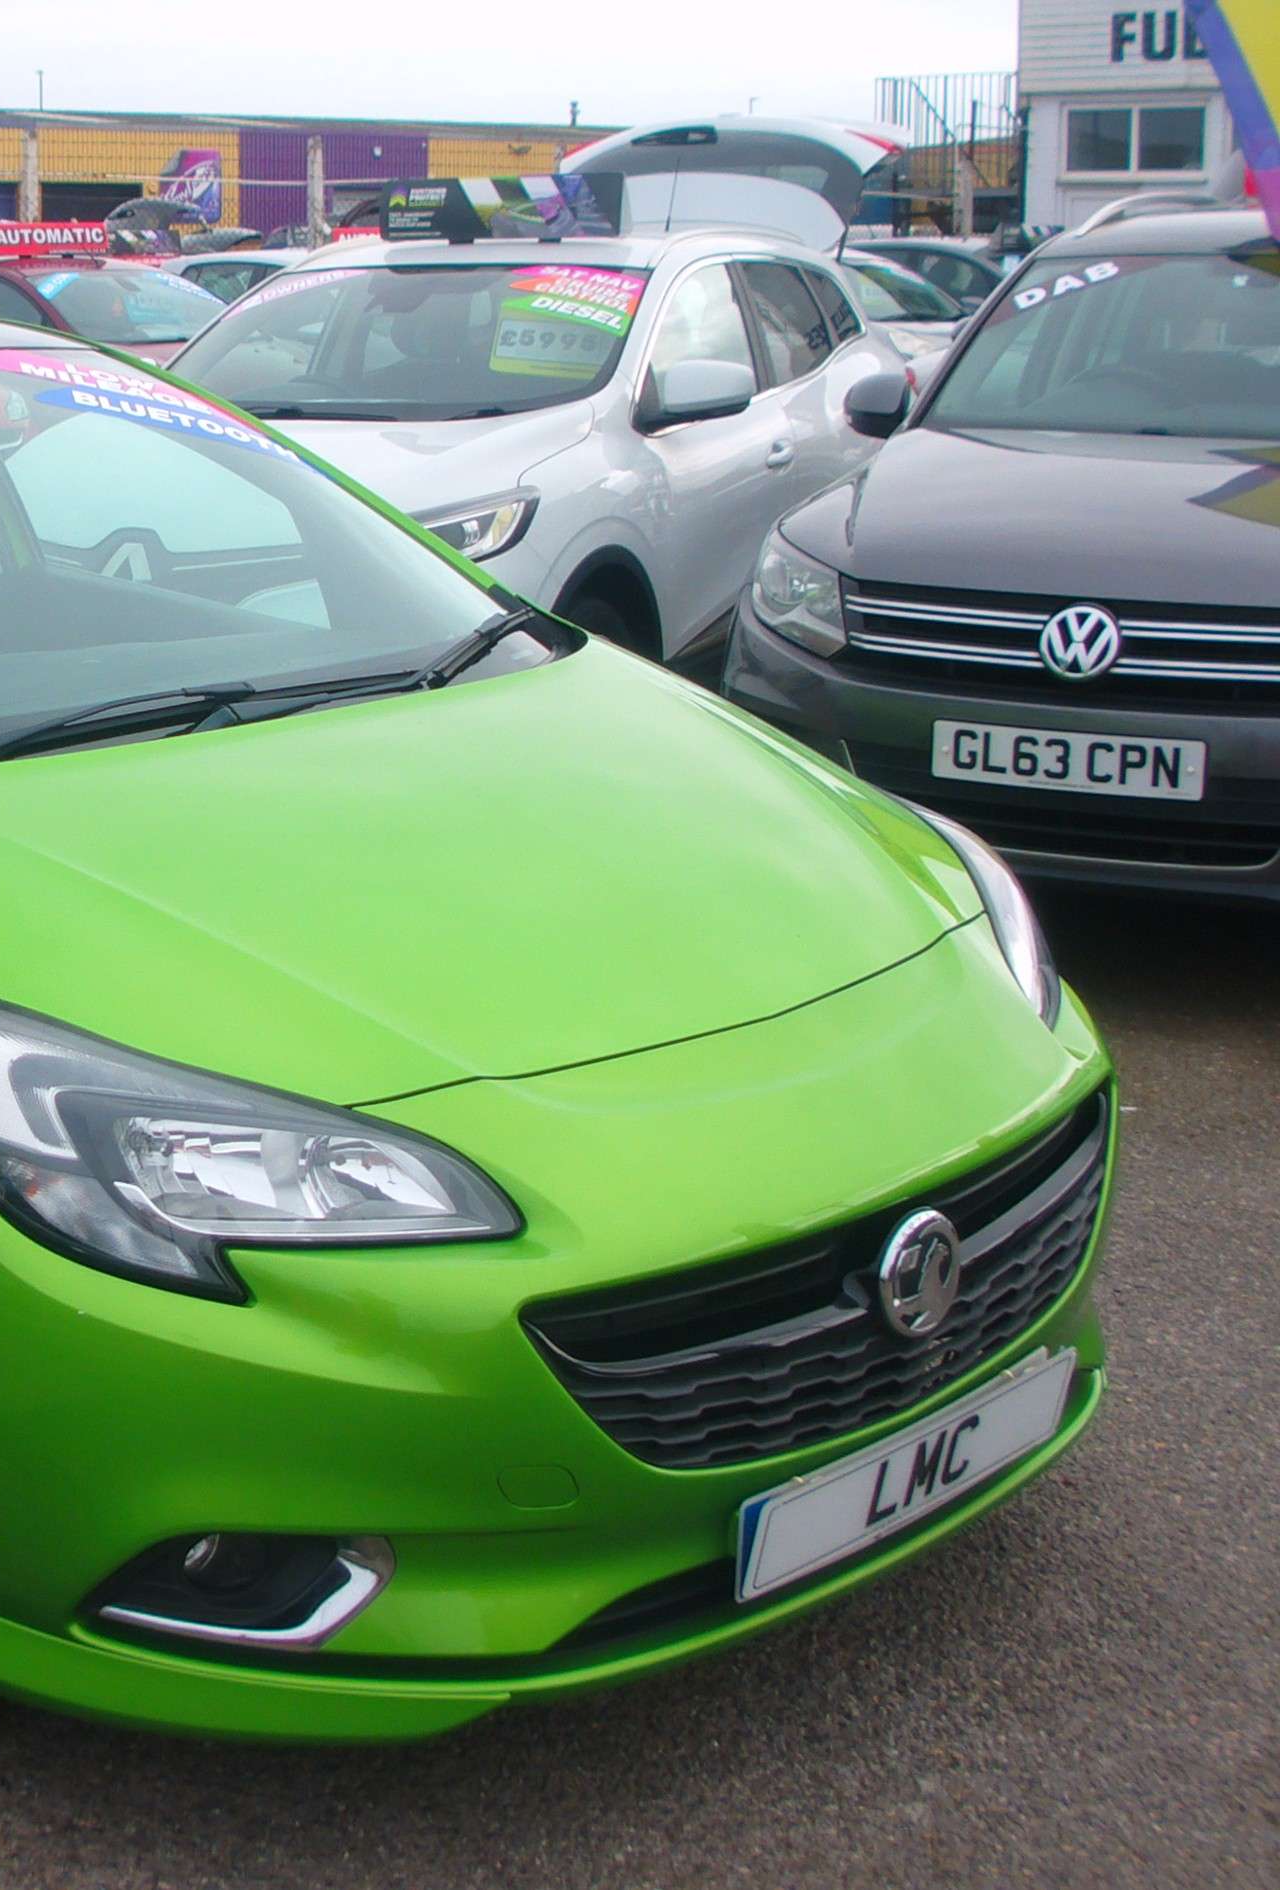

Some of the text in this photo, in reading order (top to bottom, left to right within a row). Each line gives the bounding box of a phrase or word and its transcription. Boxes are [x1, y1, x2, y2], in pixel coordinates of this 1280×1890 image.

[539, 265, 641, 290] SAT NAV
[1013, 261, 1120, 310] DAB
[529, 296, 625, 332] DIESEL
[64, 363, 157, 391] LOW
[952, 729, 1181, 788] GL63 CPN
[865, 1415, 981, 1527] LMC
